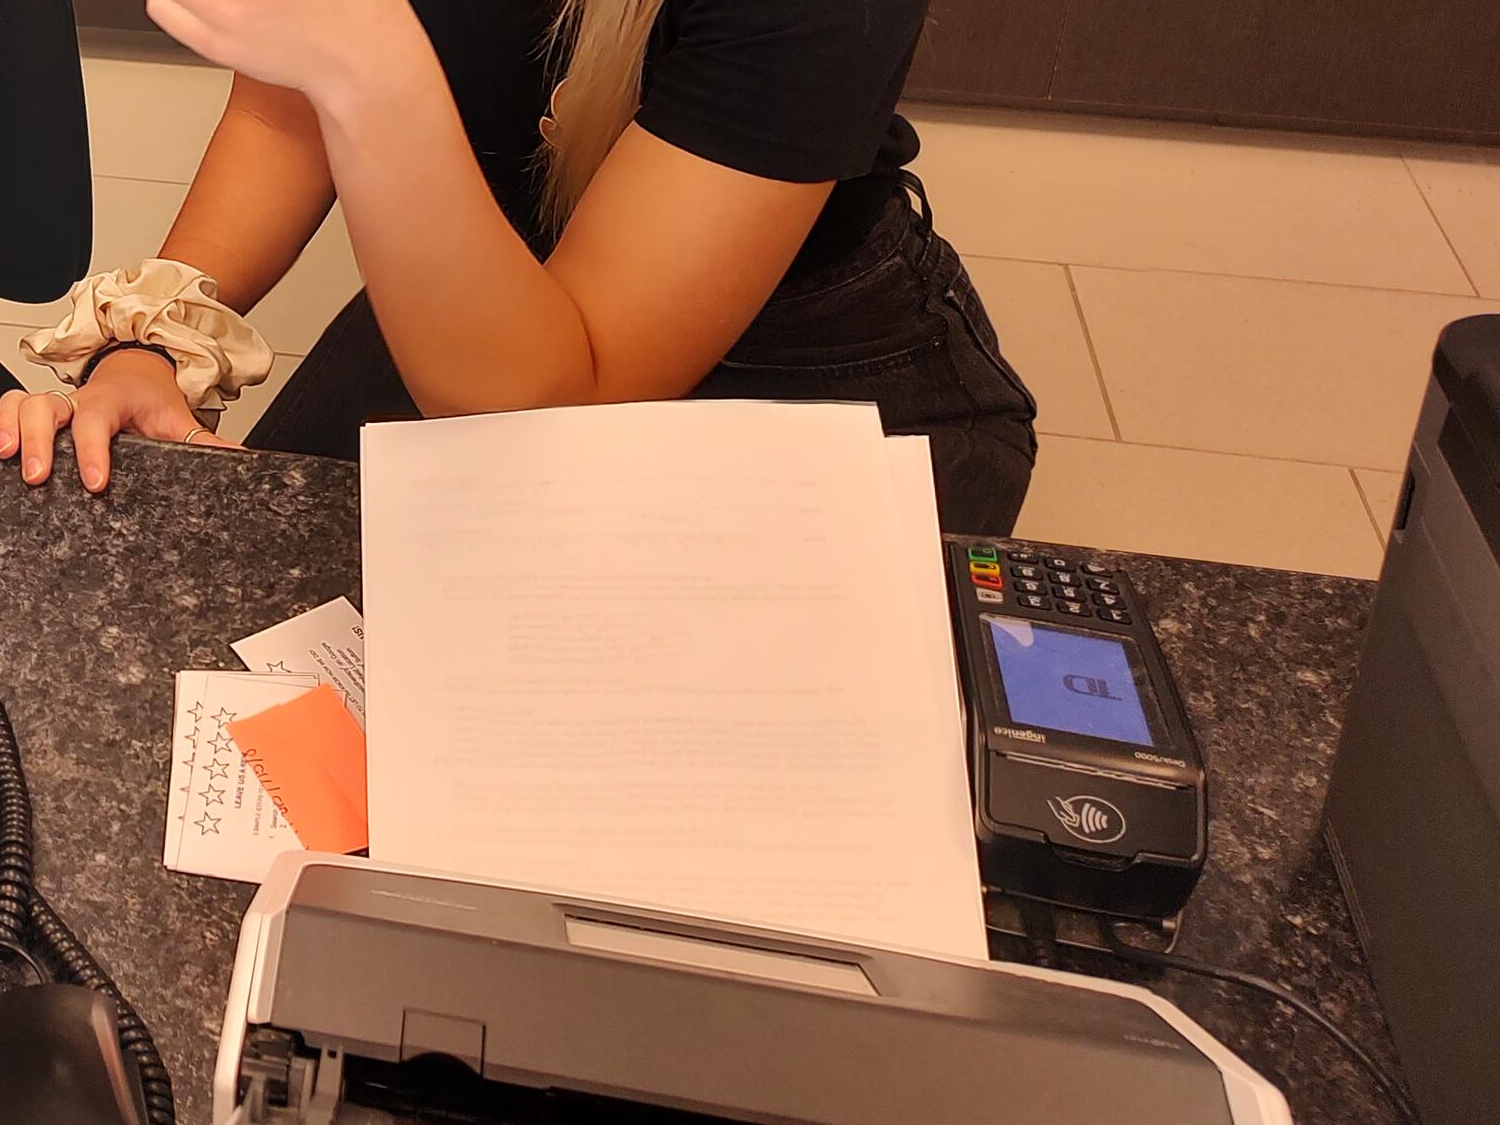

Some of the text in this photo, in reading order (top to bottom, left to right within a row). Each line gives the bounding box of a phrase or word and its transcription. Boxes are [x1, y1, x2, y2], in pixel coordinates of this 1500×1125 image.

[1063, 674, 1122, 702] TD
[994, 726, 1047, 745] ingenico
[1134, 751, 1186, 768] Desk/5000
[237, 775, 245, 785] US
[234, 786, 245, 809] LEAVE
